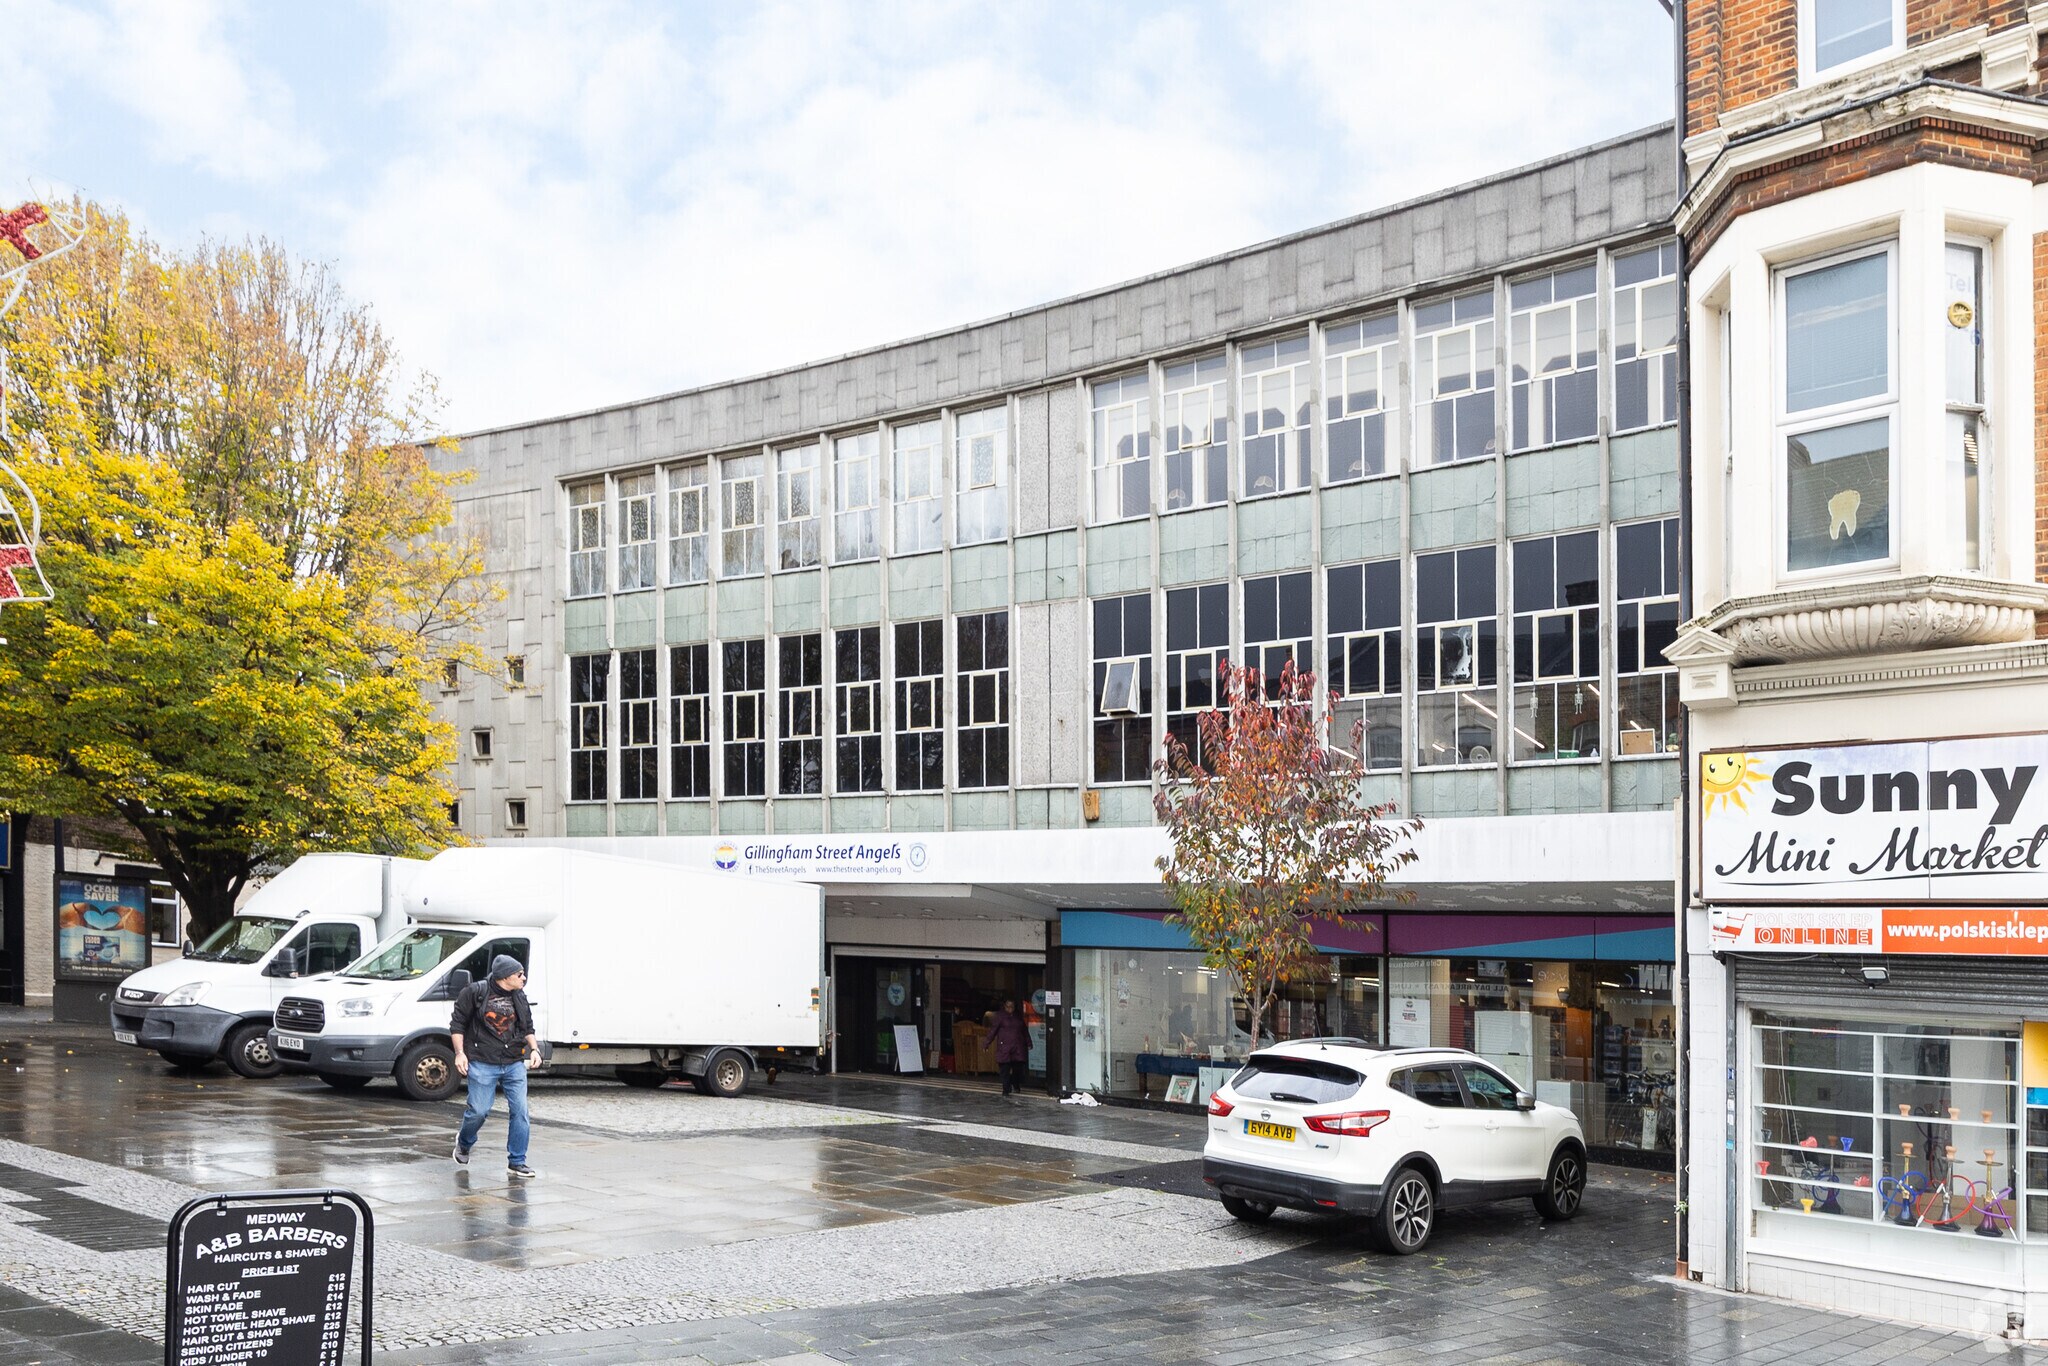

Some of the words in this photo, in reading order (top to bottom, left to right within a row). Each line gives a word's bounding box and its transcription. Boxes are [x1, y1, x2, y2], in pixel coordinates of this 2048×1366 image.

[1771, 760, 2039, 825] Sunny
[745, 843, 812, 863] Gillingham
[816, 843, 855, 860] Street
[856, 842, 901, 863] Angels
[1715, 830, 1836, 877] Mini
[1849, 824, 2048, 873] Market
[755, 865, 807, 875] TheStreetAngels
[816, 865, 902, 875] www.thestreet-angels.org
[84, 883, 119, 893] OCEAN
[84, 892, 120, 902] SAVER
[1754, 912, 1815, 927] POLSKI
[1818, 913, 1873, 928] SKLEP
[1757, 927, 1870, 945] ONLINE
[1273, 1125, 1293, 1139] AVB
[246, 1212, 306, 1225] MEDWAY
[196, 1232, 243, 1259] A&B
[248, 1226, 348, 1249] BARBERS
[214, 1250, 272, 1263] HAIRCUTS
[274, 1250, 283, 1259] &
[285, 1247, 328, 1258] SHAVES
[242, 1266, 275, 1277] PRICE
[277, 1264, 300, 1274] LIST
[186, 1294, 219, 1304] WASH
[222, 1293, 230, 1301] &
[233, 1290, 261, 1300] FADE
[327, 1283, 345, 1292] £15
[187, 1284, 214, 1294] HAIR
[217, 1282, 240, 1291] CUT
[328, 1273, 346, 1282] £12
[184, 1316, 208, 1325] HOT
[210, 1312, 249, 1323] TOWEL
[251, 1308, 286, 1318] SHAVE
[325, 1302, 342, 1311] £12
[185, 1305, 212, 1315] SKIN
[214, 1302, 243, 1312] FADE
[326, 1293, 344, 1301] £14
[182, 1336, 209, 1346] HAIR
[212, 1333, 234, 1343] CUT
[237, 1332, 244, 1340] &
[247, 1328, 282, 1339] SHAVE
[323, 1321, 340, 1330] £25
[183, 1326, 207, 1336] HOT
[210, 1322, 248, 1333] TOWEL
[250, 1319, 279, 1328] HEAD
[282, 1315, 316, 1325] SHAVE
[324, 1312, 341, 1320] £12
[180, 1344, 223, 1356] SENIOR
[226, 1339, 273, 1351] CITIZENS
[322, 1331, 339, 1340] £10
[180, 1357, 206, 1366] KIDS
[215, 1351, 253, 1362] UNDER
[256, 1349, 268, 1358] 10
[321, 1340, 338, 1349] £10
